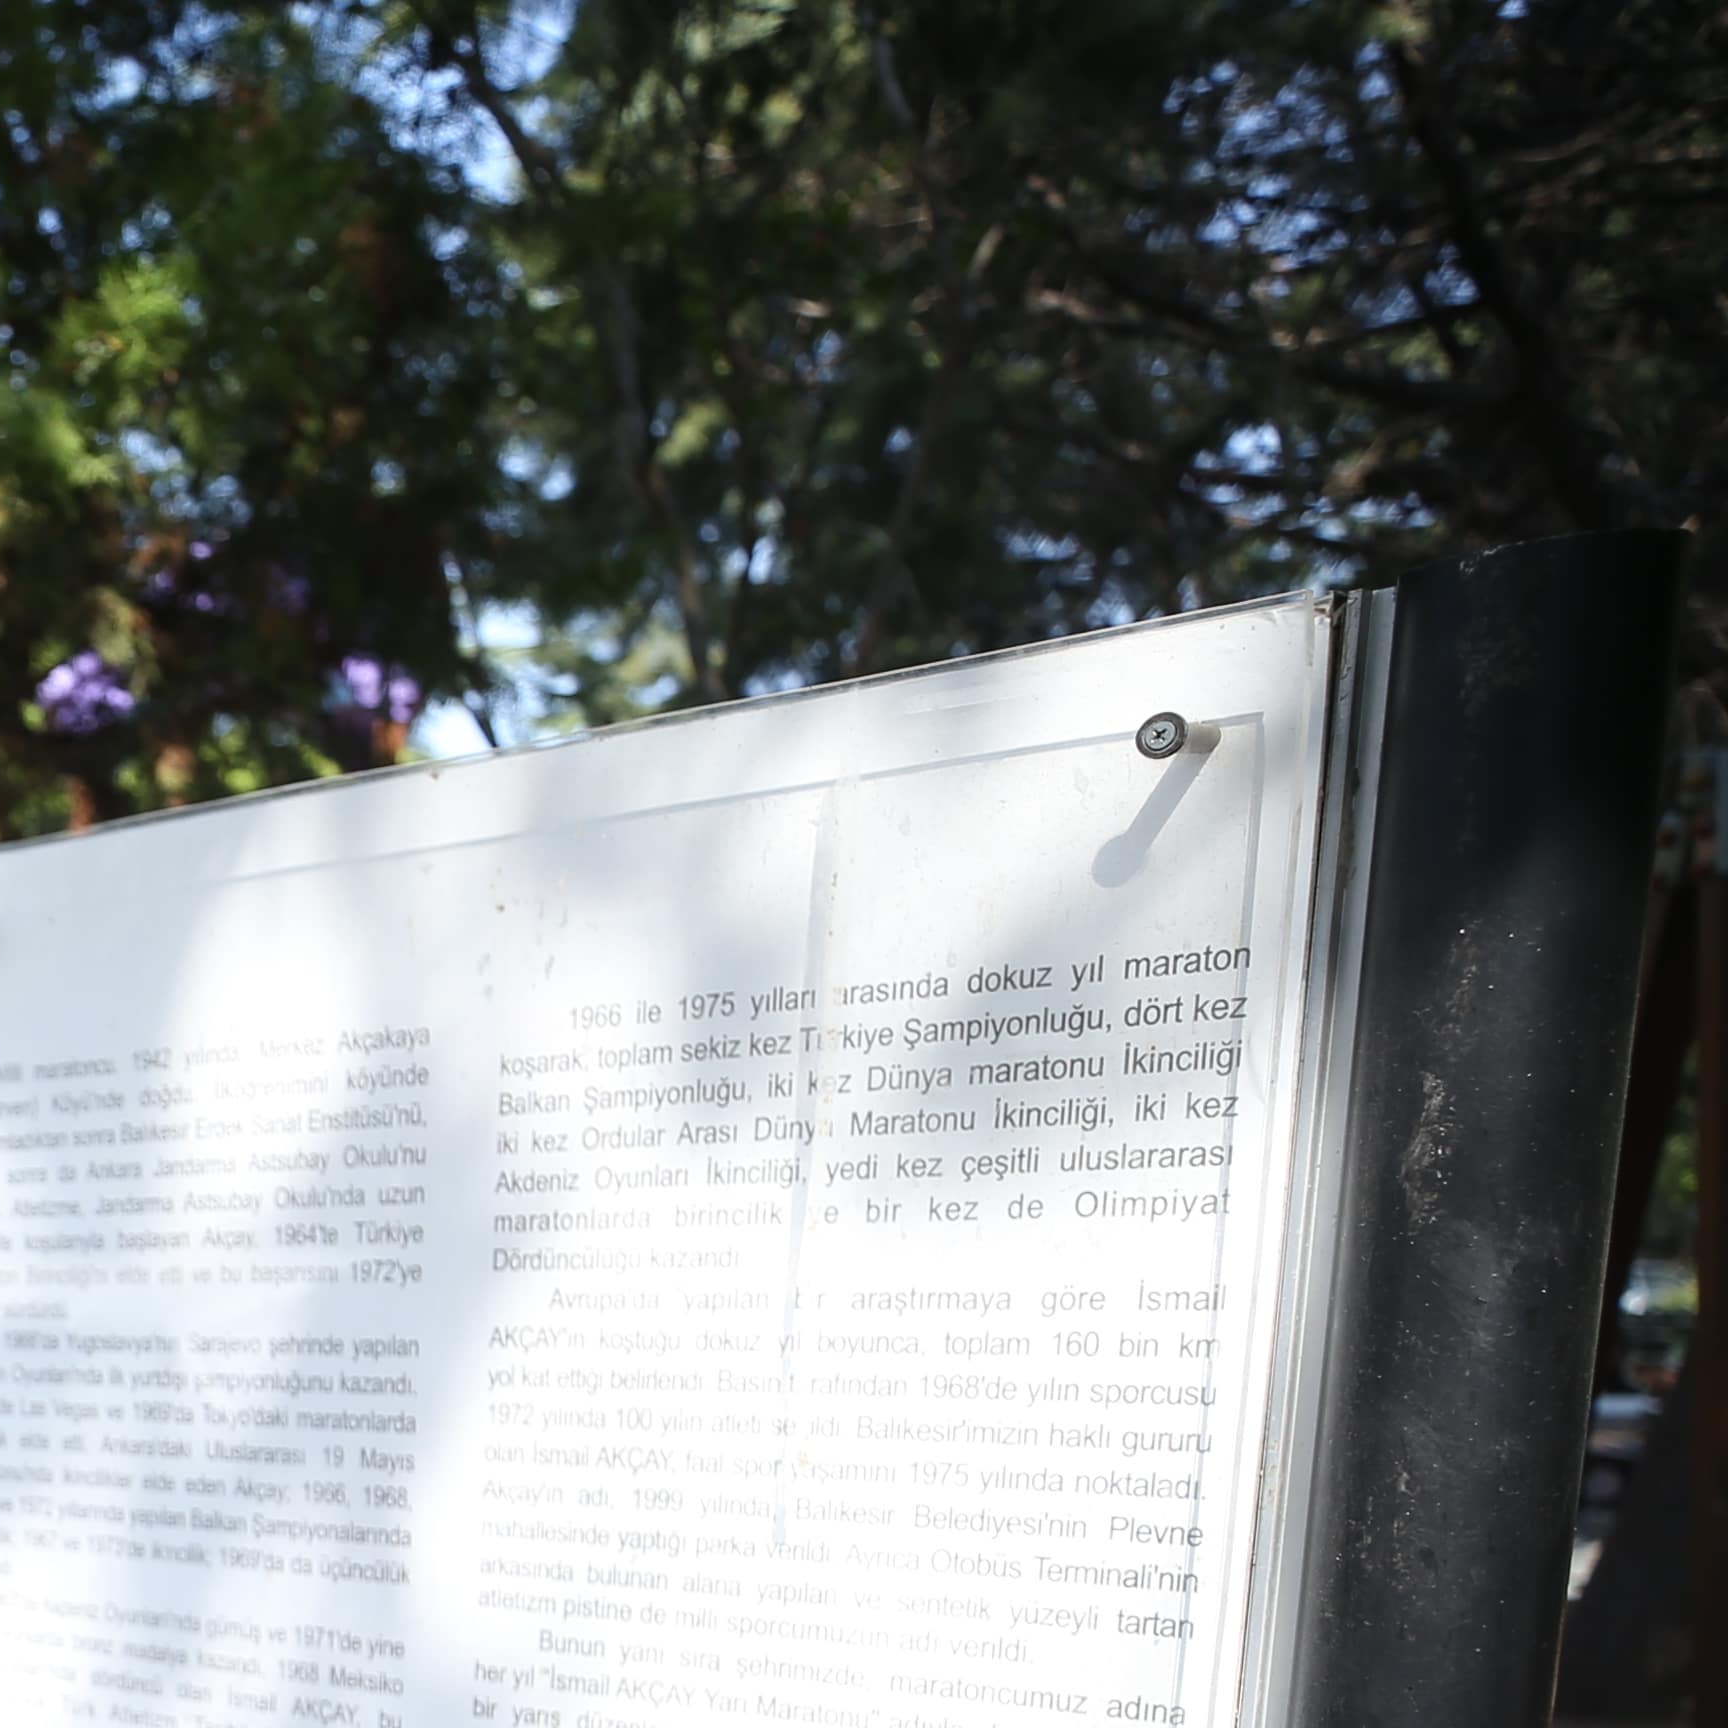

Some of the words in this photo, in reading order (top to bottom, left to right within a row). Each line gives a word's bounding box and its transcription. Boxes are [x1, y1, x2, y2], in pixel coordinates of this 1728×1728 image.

[569, 1003, 622, 1031] 1966
[636, 1000, 662, 1025] ile
[678, 991, 736, 1021] 1975
[749, 986, 816, 1021] yılları
[967, 964, 1053, 994] dokuz
[1071, 954, 1104, 992] yıl
[1123, 946, 1251, 980] maraton
[598, 1043, 673, 1072] toplam
[681, 1034, 741, 1063] sekiz
[749, 1033, 791, 1056] kez
[903, 1004, 1112, 1051] Şampiyonluğu,
[1124, 997, 1182, 1027] dört
[1192, 994, 1247, 1020] kez
[498, 1091, 570, 1118] Balkan
[583, 1076, 752, 1115] Şampiyonluğu,
[766, 1072, 793, 1098] iki
[867, 1065, 952, 1094] Dünya
[968, 1054, 1104, 1086] maratonu
[1122, 1040, 1242, 1076] İkinciliği
[496, 1132, 518, 1155] iki
[531, 1128, 568, 1152] kez
[581, 1124, 665, 1152] Ordular
[676, 1121, 738, 1147] Arası
[850, 1109, 976, 1137] Maratonu
[994, 1097, 1114, 1131] İkinciliği,
[1134, 1094, 1166, 1122] iki
[1185, 1092, 1238, 1119] kez
[494, 1169, 579, 1194] Akdeniz
[594, 1166, 689, 1194] Oyunları
[706, 1155, 807, 1188] İkinciliği,
[826, 1154, 877, 1187] yedi
[896, 1152, 942, 1178] kez
[961, 1146, 1040, 1182] çeşitli
[1060, 1143, 1233, 1173] uluslararası
[494, 1208, 650, 1233] maratonlarda
[866, 1197, 902, 1223] bir
[929, 1197, 979, 1222] kez
[1007, 1194, 1043, 1220] de
[1074, 1188, 1230, 1222] Olimpiyat
[851, 1287, 1011, 1317] araştırmaya
[1040, 1285, 1105, 1317] göre
[1137, 1279, 1227, 1311] İsmail
[695, 1329, 761, 1351] dokuz
[945, 1331, 1030, 1360] toplam
[1052, 1331, 1099, 1357] 160
[1118, 1332, 1158, 1357] bin
[1179, 1333, 1220, 1359] km
[488, 1365, 515, 1391] yol
[522, 1365, 550, 1387] kat
[919, 1374, 1017, 1400] 1968'de
[1028, 1378, 1079, 1407] yılın
[1090, 1384, 1217, 1410] sporcusu
[488, 1403, 534, 1426] 1972
[617, 1407, 652, 1431] 100
[1049, 1423, 1110, 1449] haklı
[1122, 1428, 1211, 1456] gururu
[685, 1448, 723, 1473] faal
[732, 1456, 782, 1482] spor
[911, 1461, 969, 1487] 1975
[980, 1466, 1063, 1494] yılında
[1075, 1471, 1206, 1501] noktaladı.
[633, 1488, 683, 1511] 1999
[915, 1505, 1087, 1539] Belediyesi'nin
[1109, 1515, 1204, 1547] Plevne
[481, 1519, 609, 1547] mahallesinde
[696, 1534, 755, 1559] parka
[845, 1543, 920, 1572] Ayrıca
[931, 1548, 1022, 1580] Otobüs
[1034, 1556, 1199, 1593] Terminali'nin
[479, 1556, 574, 1583] arkasında
[586, 1565, 668, 1591] bulunan
[682, 1571, 741, 1597] alana
[756, 1579, 836, 1606] yapılan
[853, 1589, 881, 1610] ve
[1010, 1602, 1098, 1637] yüzeyli
[1116, 1608, 1194, 1640] tartan
[640, 1602, 666, 1625] de
[727, 1614, 890, 1650] sporcumuzun
[474, 1660, 506, 1684] her
[513, 1666, 535, 1691] yıl
[615, 1677, 696, 1709] AKÇAY
[705, 1688, 746, 1715] Yarı
[539, 1628, 605, 1658] Bunun
[620, 1641, 664, 1667] yanı
[680, 1647, 721, 1673] sıra
[889, 1671, 1088, 1715] maratoncumuz
[1106, 1695, 1185, 1726] adına
[472, 1697, 497, 1719] bir
